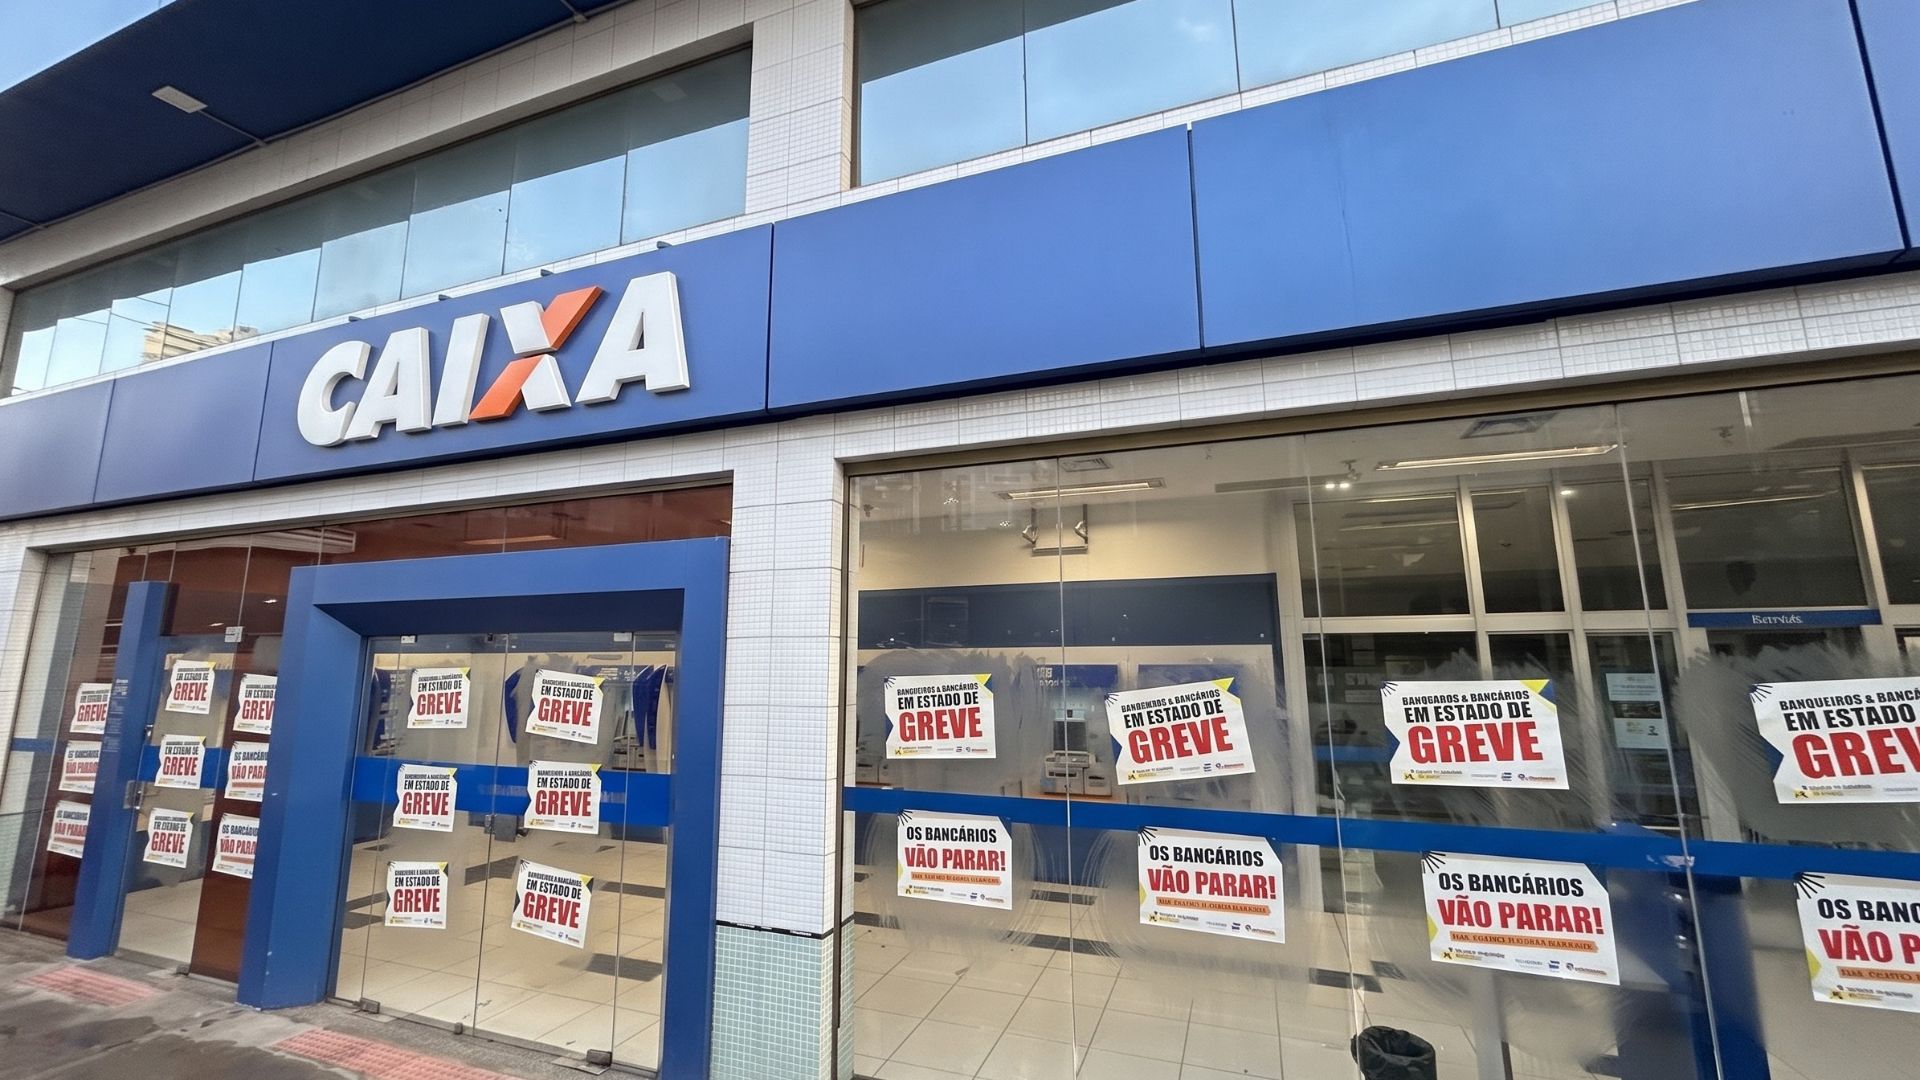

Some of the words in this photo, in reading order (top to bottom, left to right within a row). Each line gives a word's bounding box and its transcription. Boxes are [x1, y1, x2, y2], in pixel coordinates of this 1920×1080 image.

[297, 271, 690, 447] CAIXA
[174, 682, 208, 701] GREVE
[541, 685, 550, 696] EM
[553, 687, 581, 699] ESTADO
[583, 690, 593, 700] DE
[898, 696, 914, 710] EM
[917, 692, 960, 708] ESTADO
[964, 692, 979, 705] DE
[1175, 689, 1220, 704] BANCÁRIOS
[1461, 694, 1468, 703] &
[1470, 690, 1530, 702] BANCÁRIOS
[1779, 694, 1862, 710] BANQUEIROS
[1865, 695, 1875, 704] &
[417, 691, 462, 716] GREVE
[538, 697, 593, 726] GREVE
[1123, 712, 1144, 729] EM
[1147, 703, 1201, 725] ESTADO
[1204, 699, 1224, 716] DE
[1404, 706, 1431, 723] EM
[1434, 702, 1503, 722] ESTADO
[1506, 701, 1533, 718] DE
[899, 707, 982, 742] GREVE
[1783, 710, 1820, 731] EM
[1823, 704, 1916, 728] ESTADO
[1128, 716, 1234, 764] GREVE
[1408, 722, 1544, 764] GREVE
[441, 780, 450, 790] DE
[537, 777, 548, 788] EM
[550, 778, 580, 789] ESTADO
[581, 778, 591, 789] DE
[402, 792, 449, 816] GREVE
[535, 790, 591, 816] GREVE
[151, 831, 186, 854] GREVE
[906, 826, 922, 840] OS
[925, 825, 997, 843] BANCÁRIOS
[904, 844, 938, 868] VÃO
[942, 848, 1006, 871] PARAR!
[1150, 845, 1169, 861] OS
[1173, 846, 1264, 867] BANCÁRIOS
[432, 876, 440, 886] DE
[526, 879, 537, 891] EM
[539, 881, 570, 898] ESTADO
[571, 887, 582, 900] DE
[1148, 865, 1190, 894] VÃO
[1195, 871, 1276, 900] PARAR!
[1438, 872, 1464, 891] OS
[1468, 873, 1584, 897] BANCÁRIOS
[394, 889, 440, 912] GREVE
[523, 892, 581, 929] GREVE
[1817, 898, 1852, 920] OS
[1437, 895, 1492, 928] VÃO
[1498, 902, 1604, 934] PARAR!
[1818, 924, 1893, 963] VÃO
